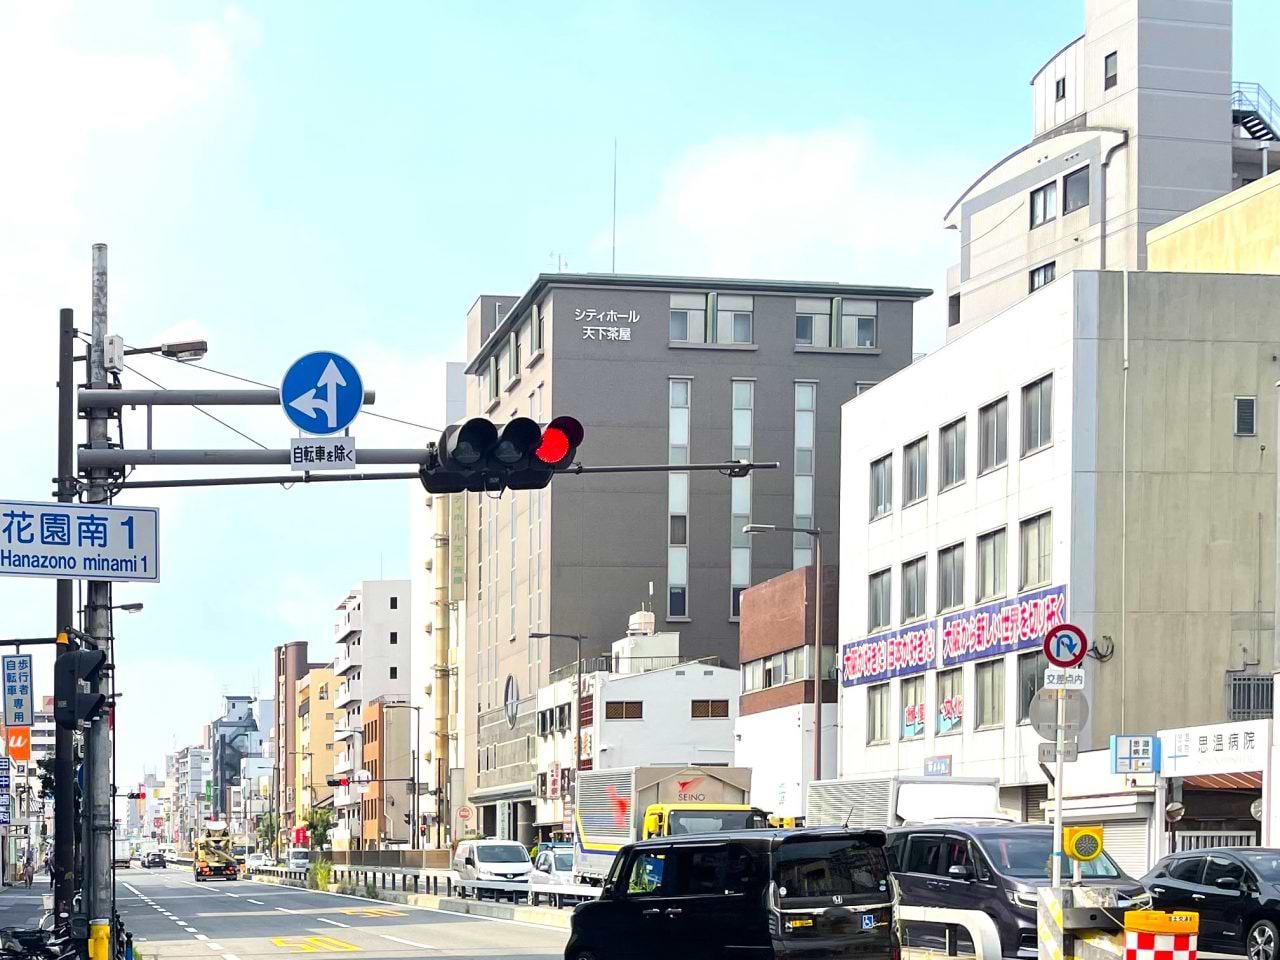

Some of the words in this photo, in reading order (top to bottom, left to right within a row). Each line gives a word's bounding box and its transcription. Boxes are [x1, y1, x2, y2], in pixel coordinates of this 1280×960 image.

[574, 308, 641, 323] シティホール
[582, 325, 632, 341] 天下茶屋
[293, 444, 353, 463] 自転車を除く
[0, 548, 77, 570] Hanazono
[6, 659, 18, 697] 自転車
[17, 658, 29, 696] 歩行者
[1046, 673, 1083, 685] 交差点内
[13, 698, 25, 723] 専用
[1198, 731, 1256, 754] 思温病院
[678, 793, 705, 802] SEINO
